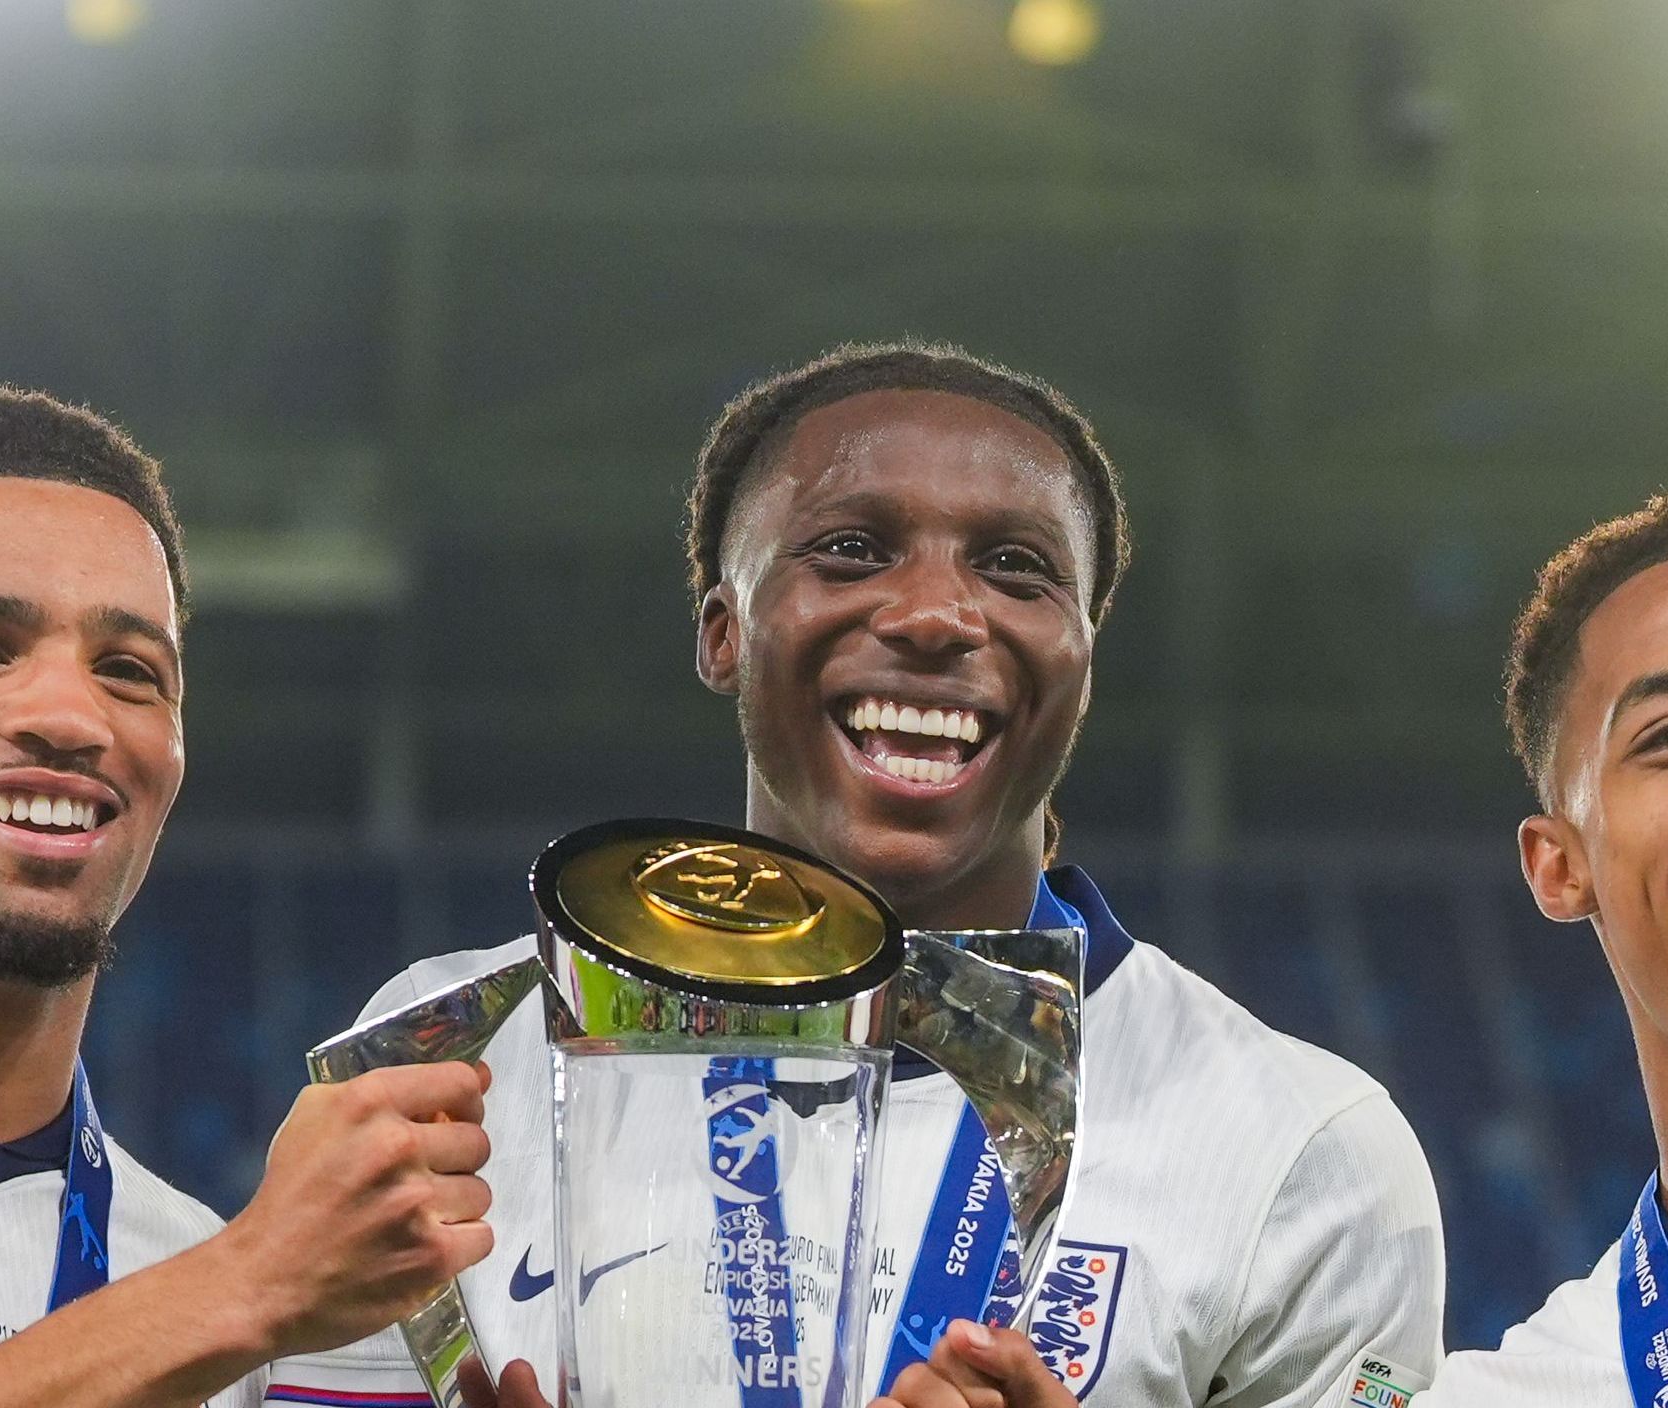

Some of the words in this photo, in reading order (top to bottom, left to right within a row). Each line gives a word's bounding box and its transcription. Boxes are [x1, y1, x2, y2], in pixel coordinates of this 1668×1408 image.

[962, 1137, 998, 1213] OVAKIA
[945, 1217, 978, 1277] 2025
[1361, 1358, 1392, 1378] UEFA
